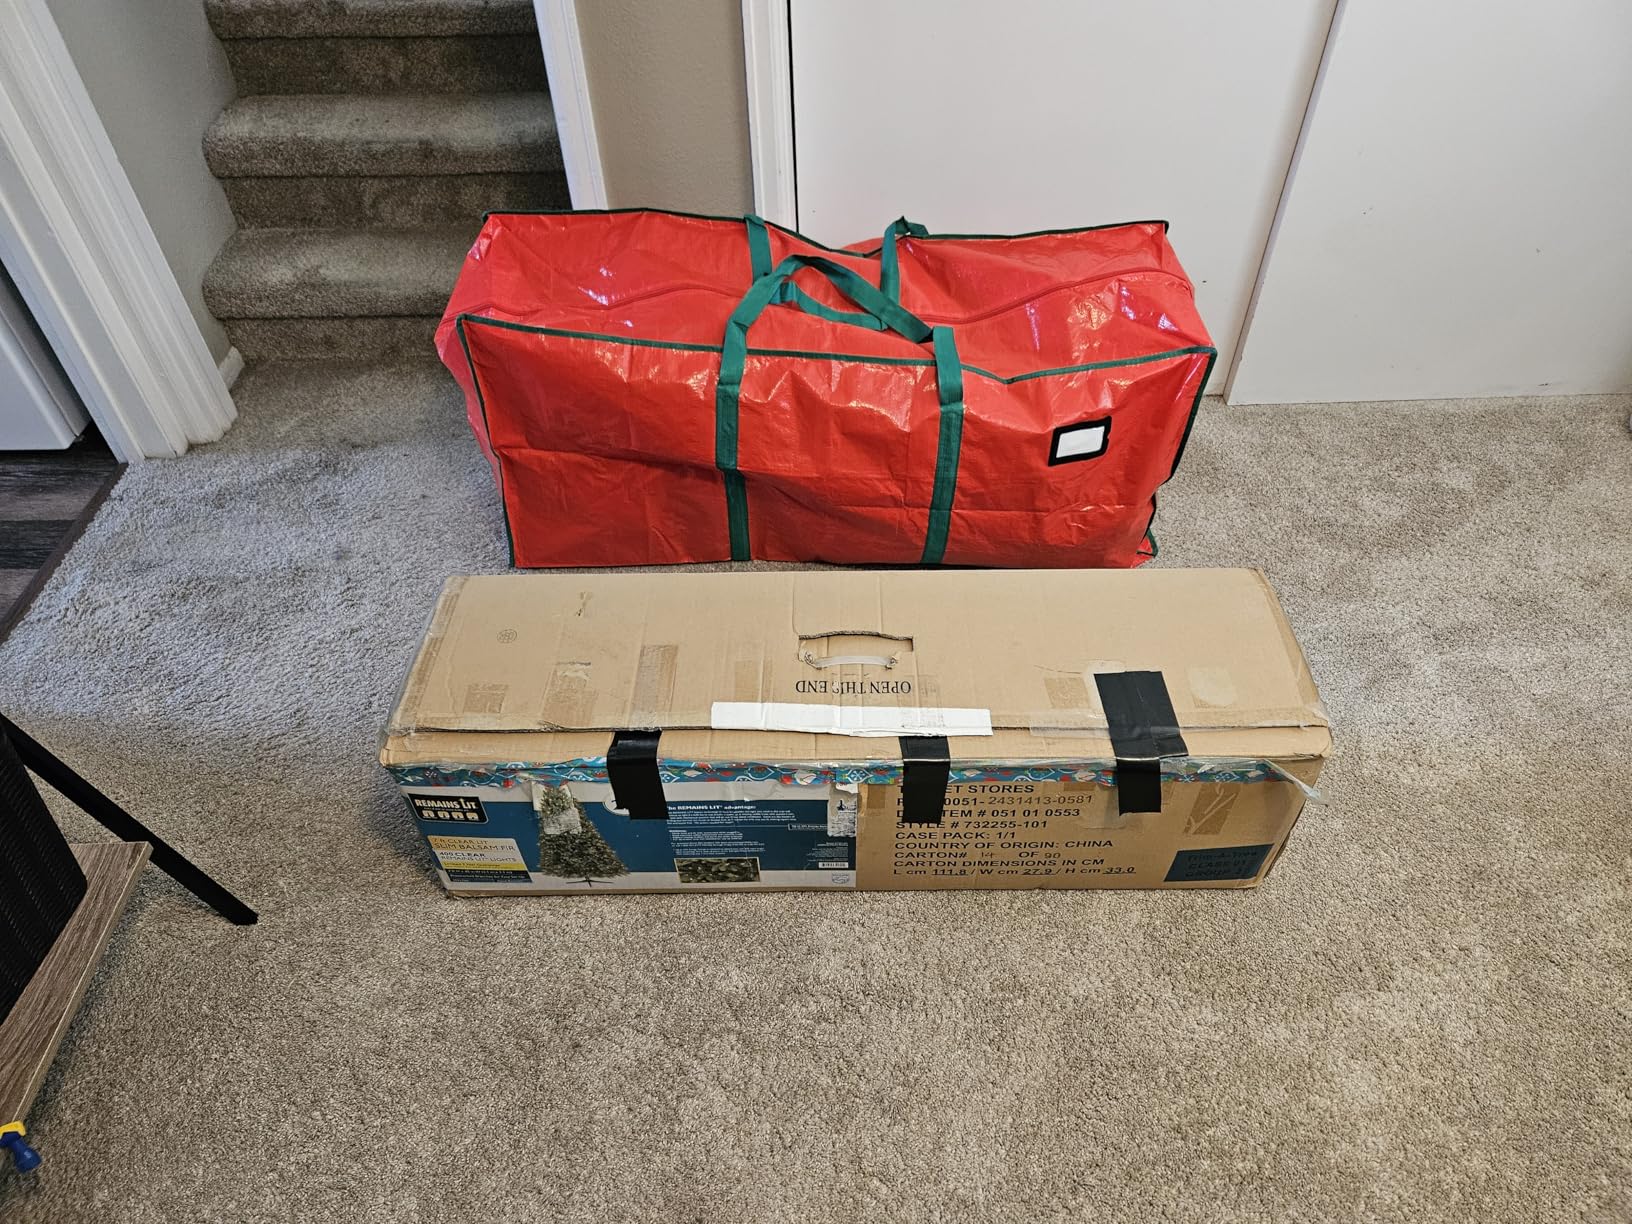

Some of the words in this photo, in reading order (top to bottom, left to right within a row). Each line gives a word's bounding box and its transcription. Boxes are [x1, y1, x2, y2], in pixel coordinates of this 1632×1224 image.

[795, 680, 828, 693] END
[832, 681, 867, 694] THIS
[870, 681, 911, 694] OPEN
[968, 784, 1034, 793] STORES
[415, 799, 460, 808] REMAINS
[460, 797, 477, 809] LIT
[991, 809, 1016, 817] 051
[1022, 809, 1039, 817] 01
[1045, 808, 1080, 817] 0553
[896, 821, 946, 829] STYLE
[964, 820, 1048, 829] 732255-101
[895, 832, 938, 840] CASE
[943, 832, 991, 840] PACK:
[996, 831, 1016, 839] 1/1
[895, 842, 970, 850] COUNTRY
[1000, 841, 1060, 849] ORIGIN:
[1065, 840, 1114, 848] CHINA
[932, 868, 968, 876] 111.8
[1103, 866, 1136, 874] 33.0
